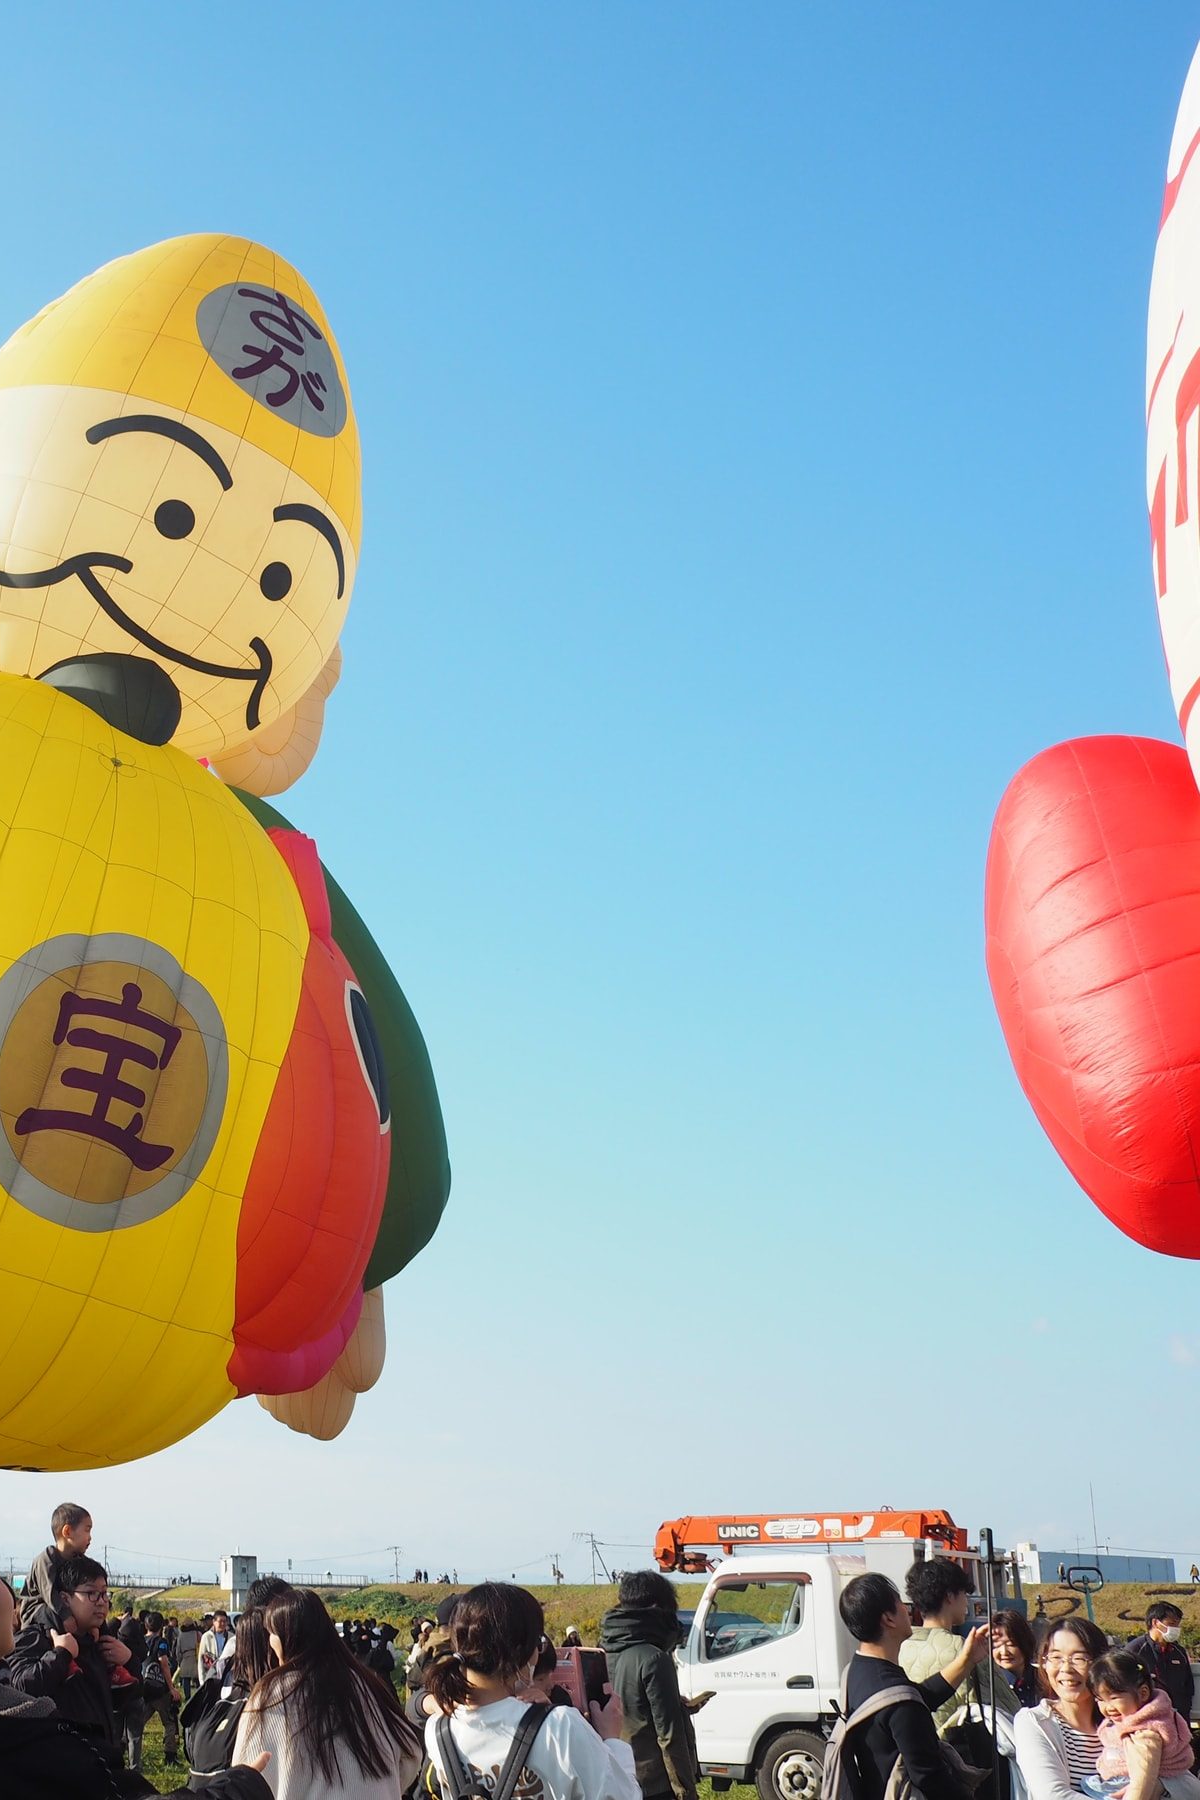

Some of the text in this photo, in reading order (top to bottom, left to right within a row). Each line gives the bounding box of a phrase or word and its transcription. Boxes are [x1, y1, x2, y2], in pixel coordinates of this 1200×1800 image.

[231, 287, 328, 412] さが
[13, 981, 182, 1172] 宝
[718, 1525, 760, 1539] UNIC
